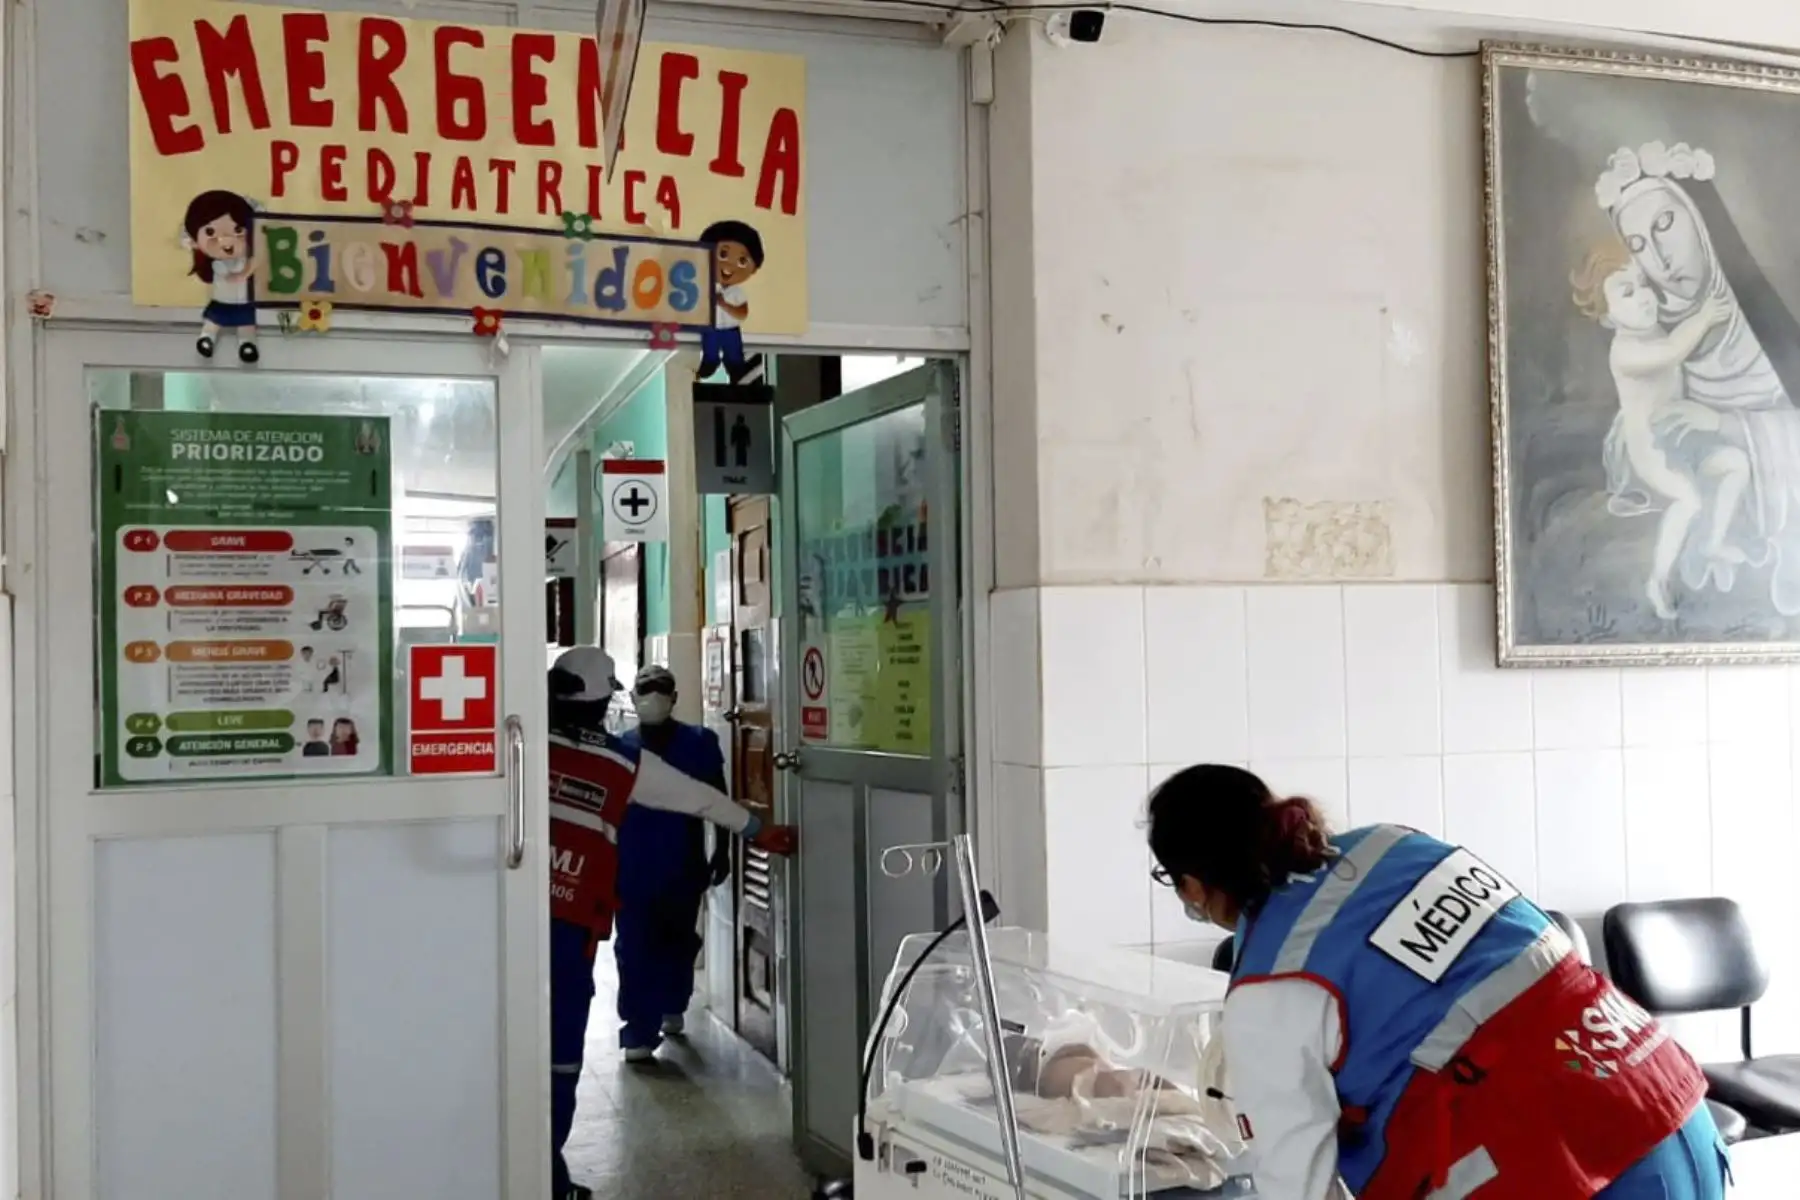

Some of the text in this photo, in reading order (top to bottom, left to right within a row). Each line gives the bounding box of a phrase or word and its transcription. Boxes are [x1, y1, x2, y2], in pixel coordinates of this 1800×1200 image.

[130, 13, 800, 216] EMERGENCIA
[270, 140, 681, 229] PEDIATRICA
[261, 225, 700, 312] Bienvenidos
[170, 428, 231, 442] SISTEMA
[233, 430, 254, 442] DE
[171, 443, 324, 462] PRIORIZADO
[210, 536, 246, 547] GRAVE
[226, 590, 284, 601] GRAVEDAD
[216, 714, 244, 726] LEVE
[234, 738, 282, 750] GENERAL
[411, 742, 494, 756] EMERGENCIA
[1399, 866, 1501, 963] MÉDICO
